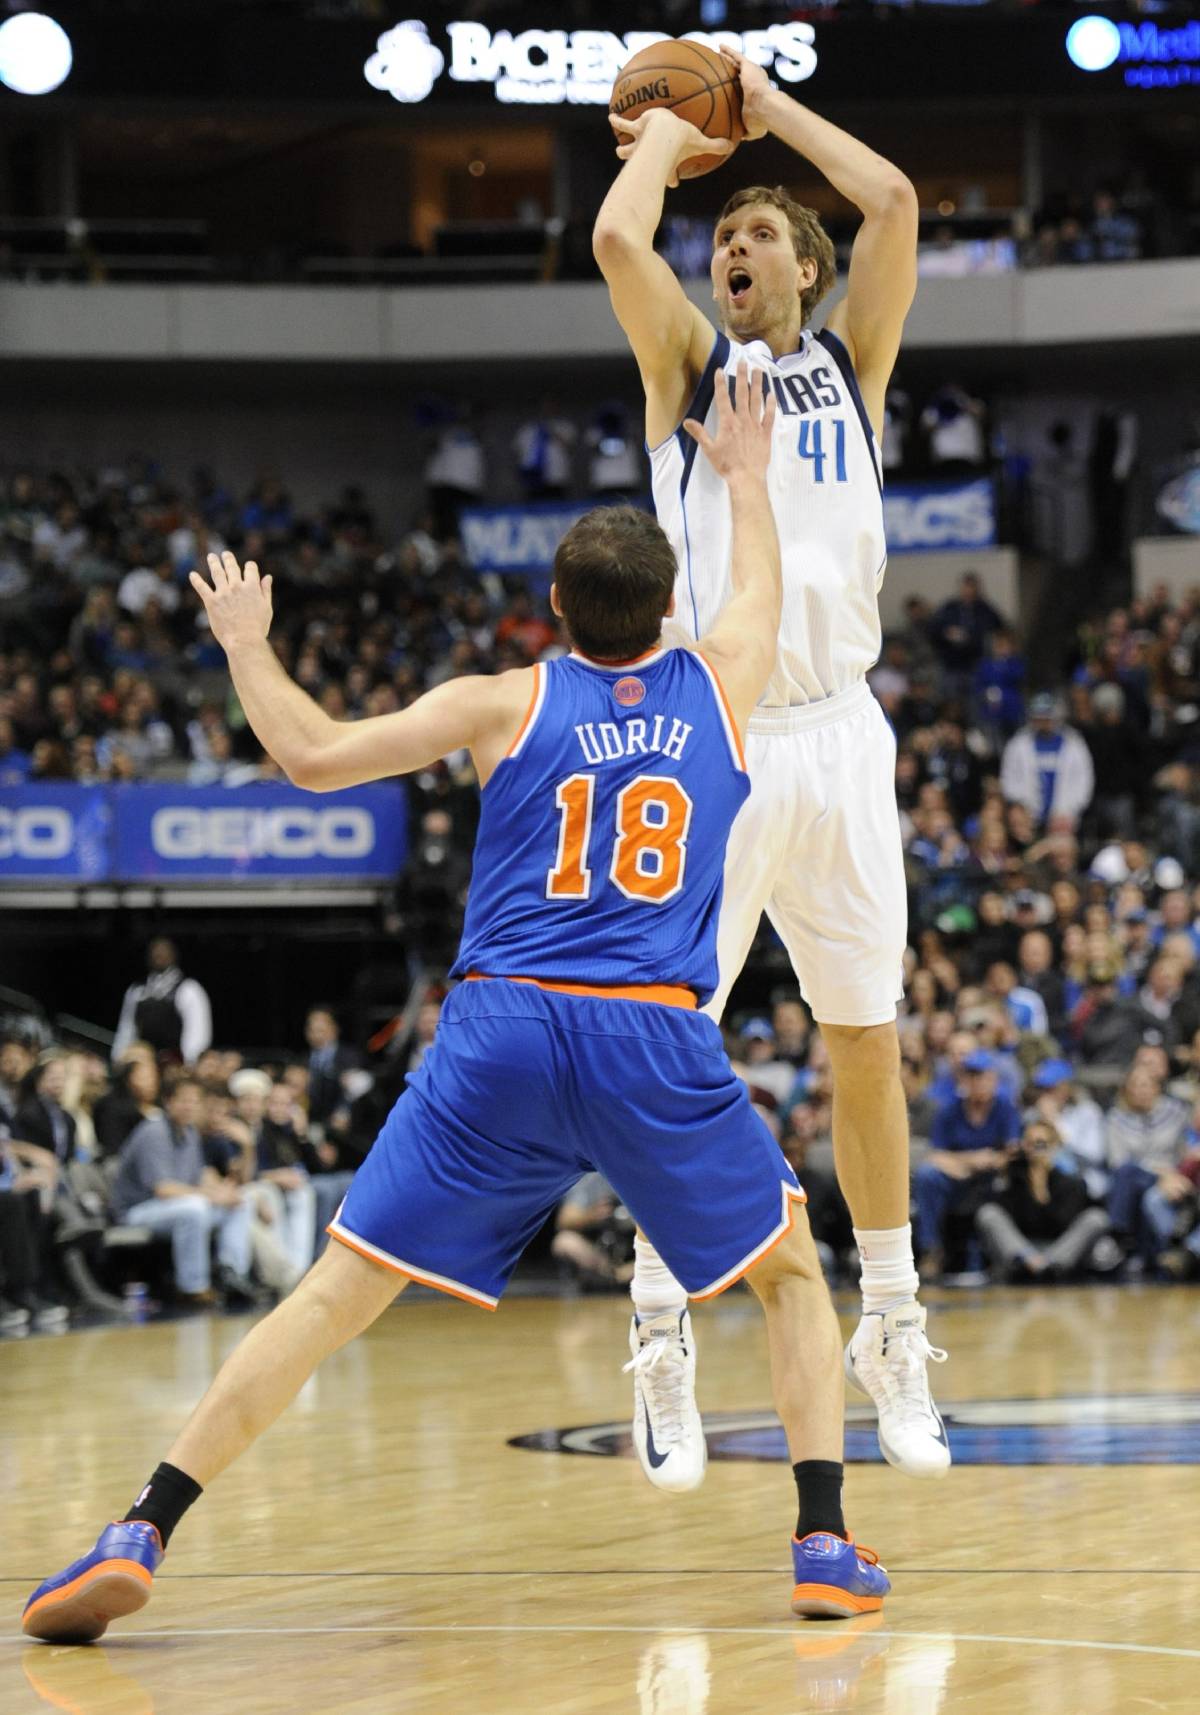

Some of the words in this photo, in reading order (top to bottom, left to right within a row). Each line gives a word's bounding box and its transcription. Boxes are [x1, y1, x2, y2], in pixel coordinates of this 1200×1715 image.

[728, 367, 841, 416] LAS
[797, 418, 848, 482] 41
[574, 714, 693, 764] UDRIH
[151, 806, 375, 859] GEICO
[546, 773, 693, 904] 18
